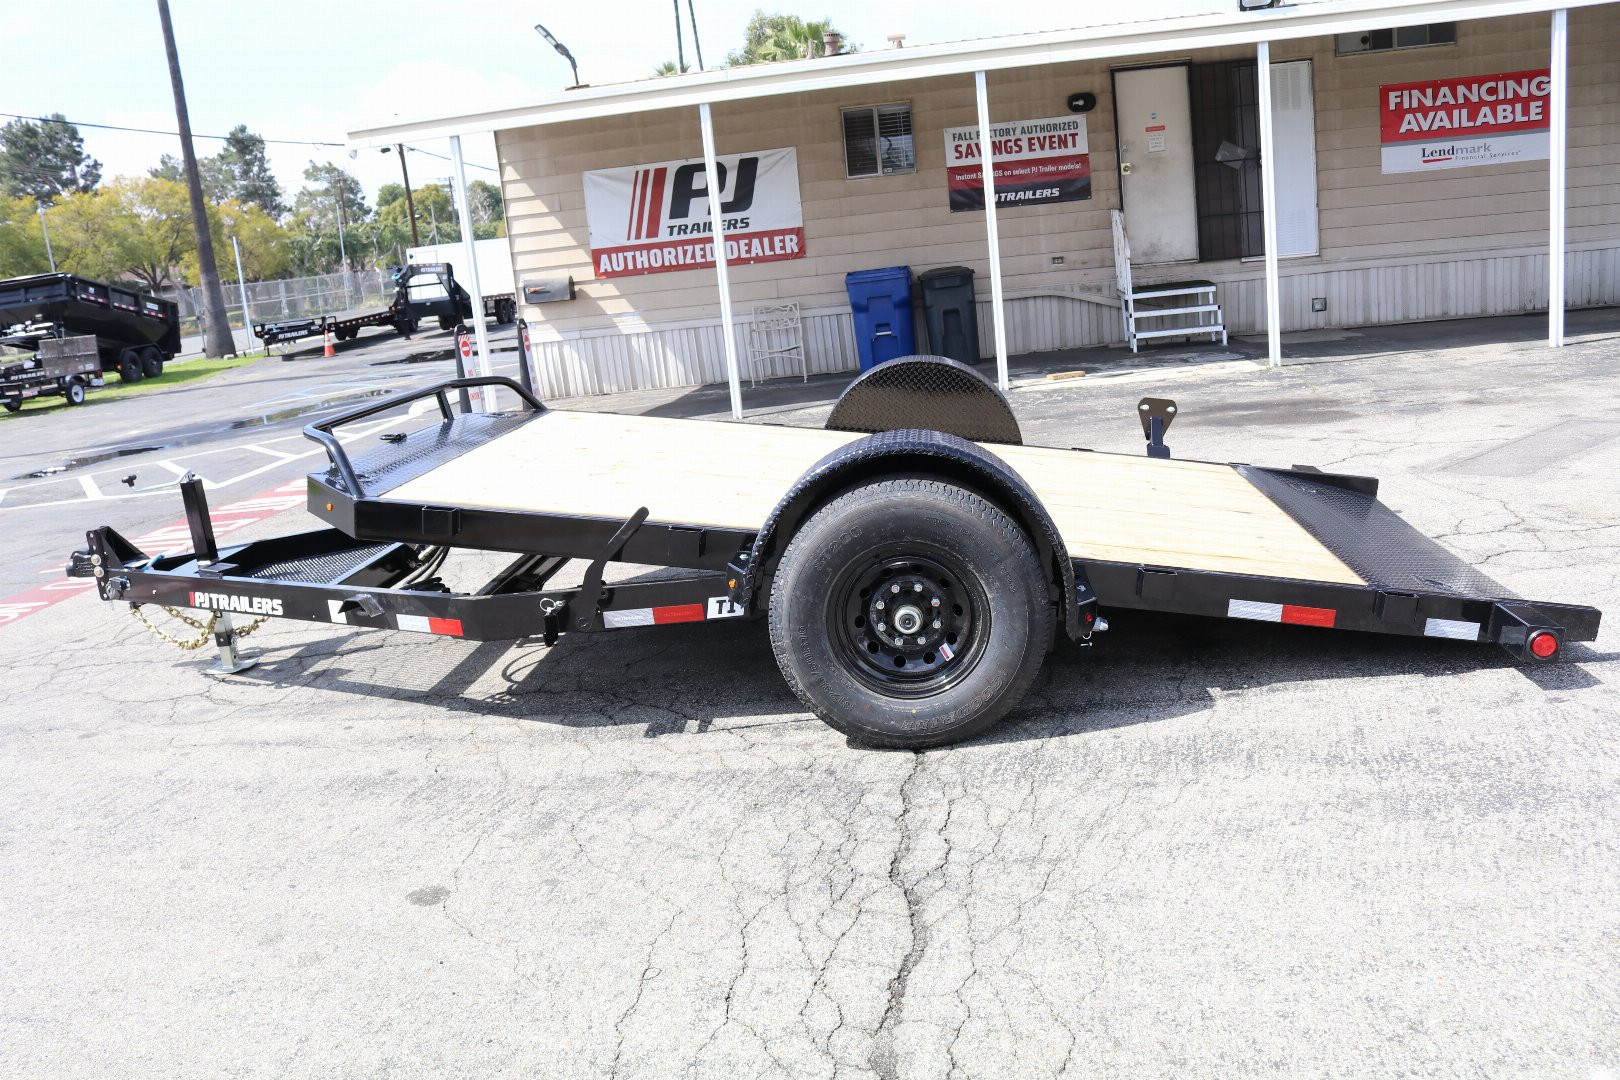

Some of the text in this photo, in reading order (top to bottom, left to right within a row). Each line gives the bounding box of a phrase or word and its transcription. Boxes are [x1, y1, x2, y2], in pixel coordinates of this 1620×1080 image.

[1388, 76, 1551, 110] FINANCING
[952, 120, 1079, 142] FALL FTORY AUTHORIZED
[1399, 101, 1543, 134] AVAILABLE
[954, 132, 1079, 160] SAVNGS EVENT
[1421, 142, 1492, 158] Lendmark
[668, 156, 759, 220] PJ
[956, 172, 976, 181] Instant
[1032, 166, 1038, 174] PJ
[599, 234, 799, 273] AUTHORIZED DEALER
